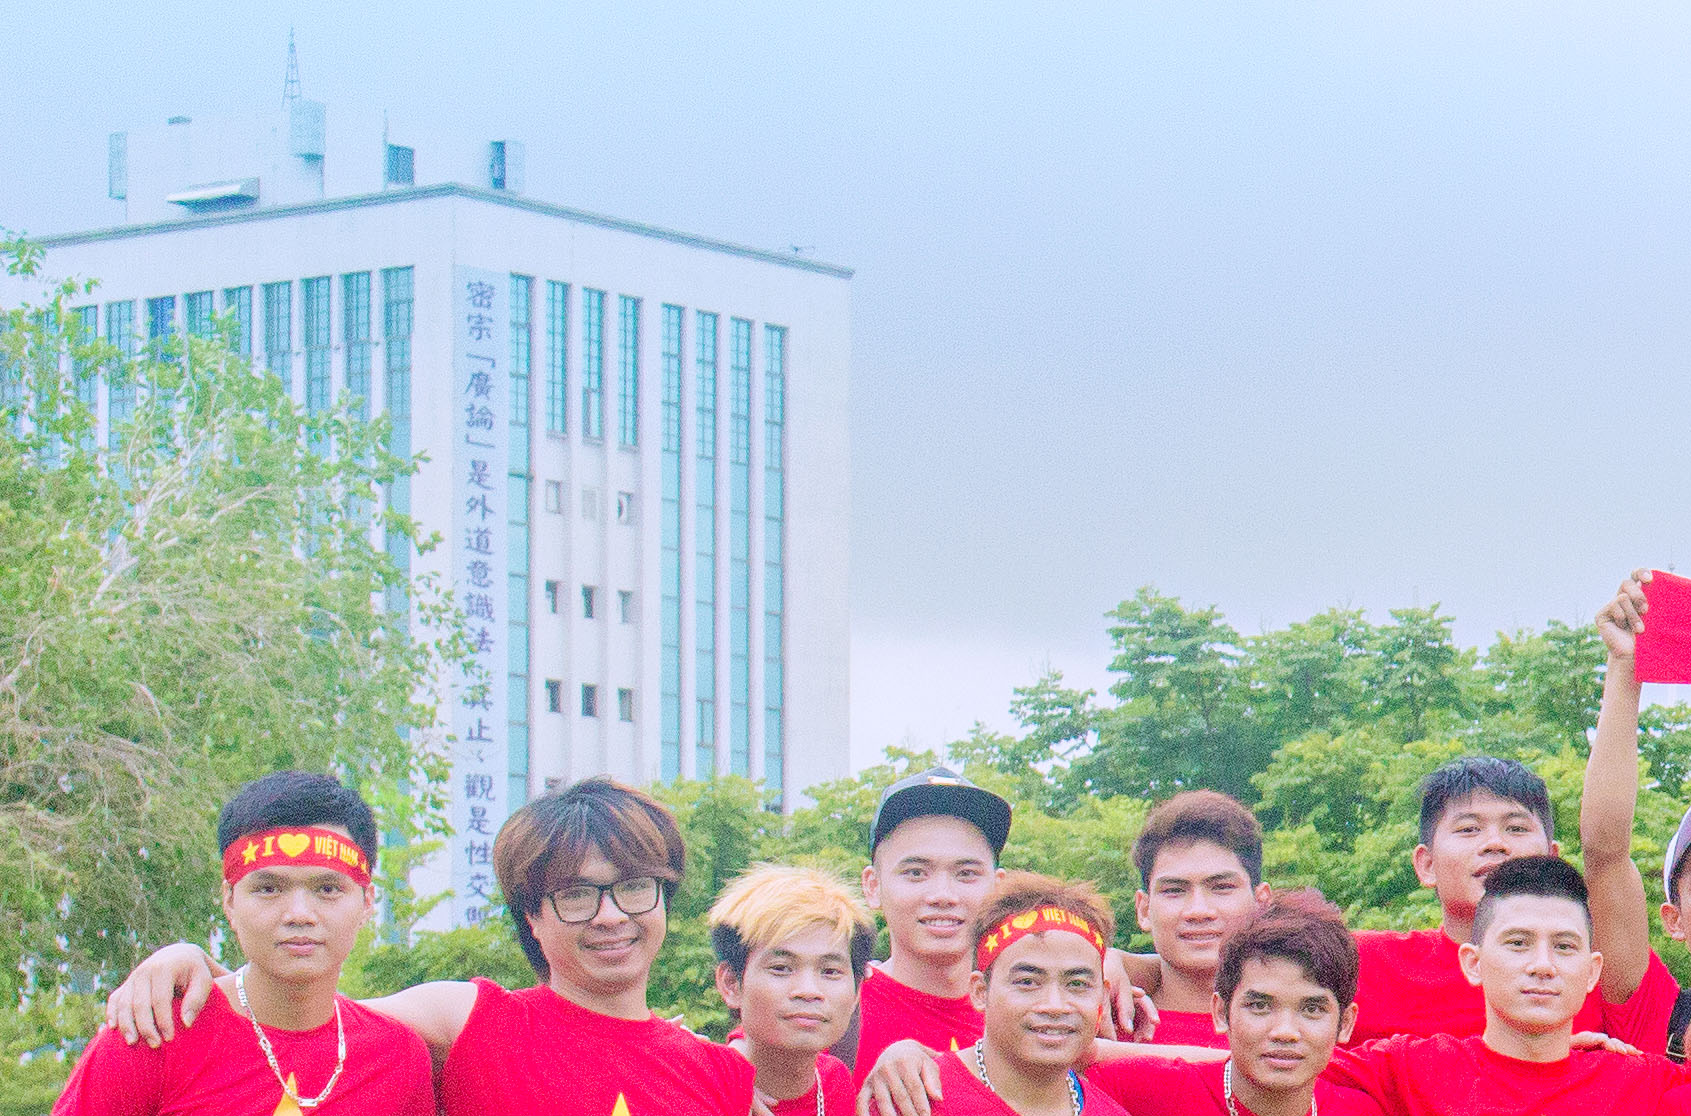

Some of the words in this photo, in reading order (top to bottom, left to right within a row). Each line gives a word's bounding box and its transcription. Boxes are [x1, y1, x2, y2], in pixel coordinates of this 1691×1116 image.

[262, 836, 275, 857] I
[315, 835, 338, 859] VIỆT
[339, 843, 359, 866] NAM
[1001, 923, 1012, 939] I
[1069, 912, 1090, 934] NAM
